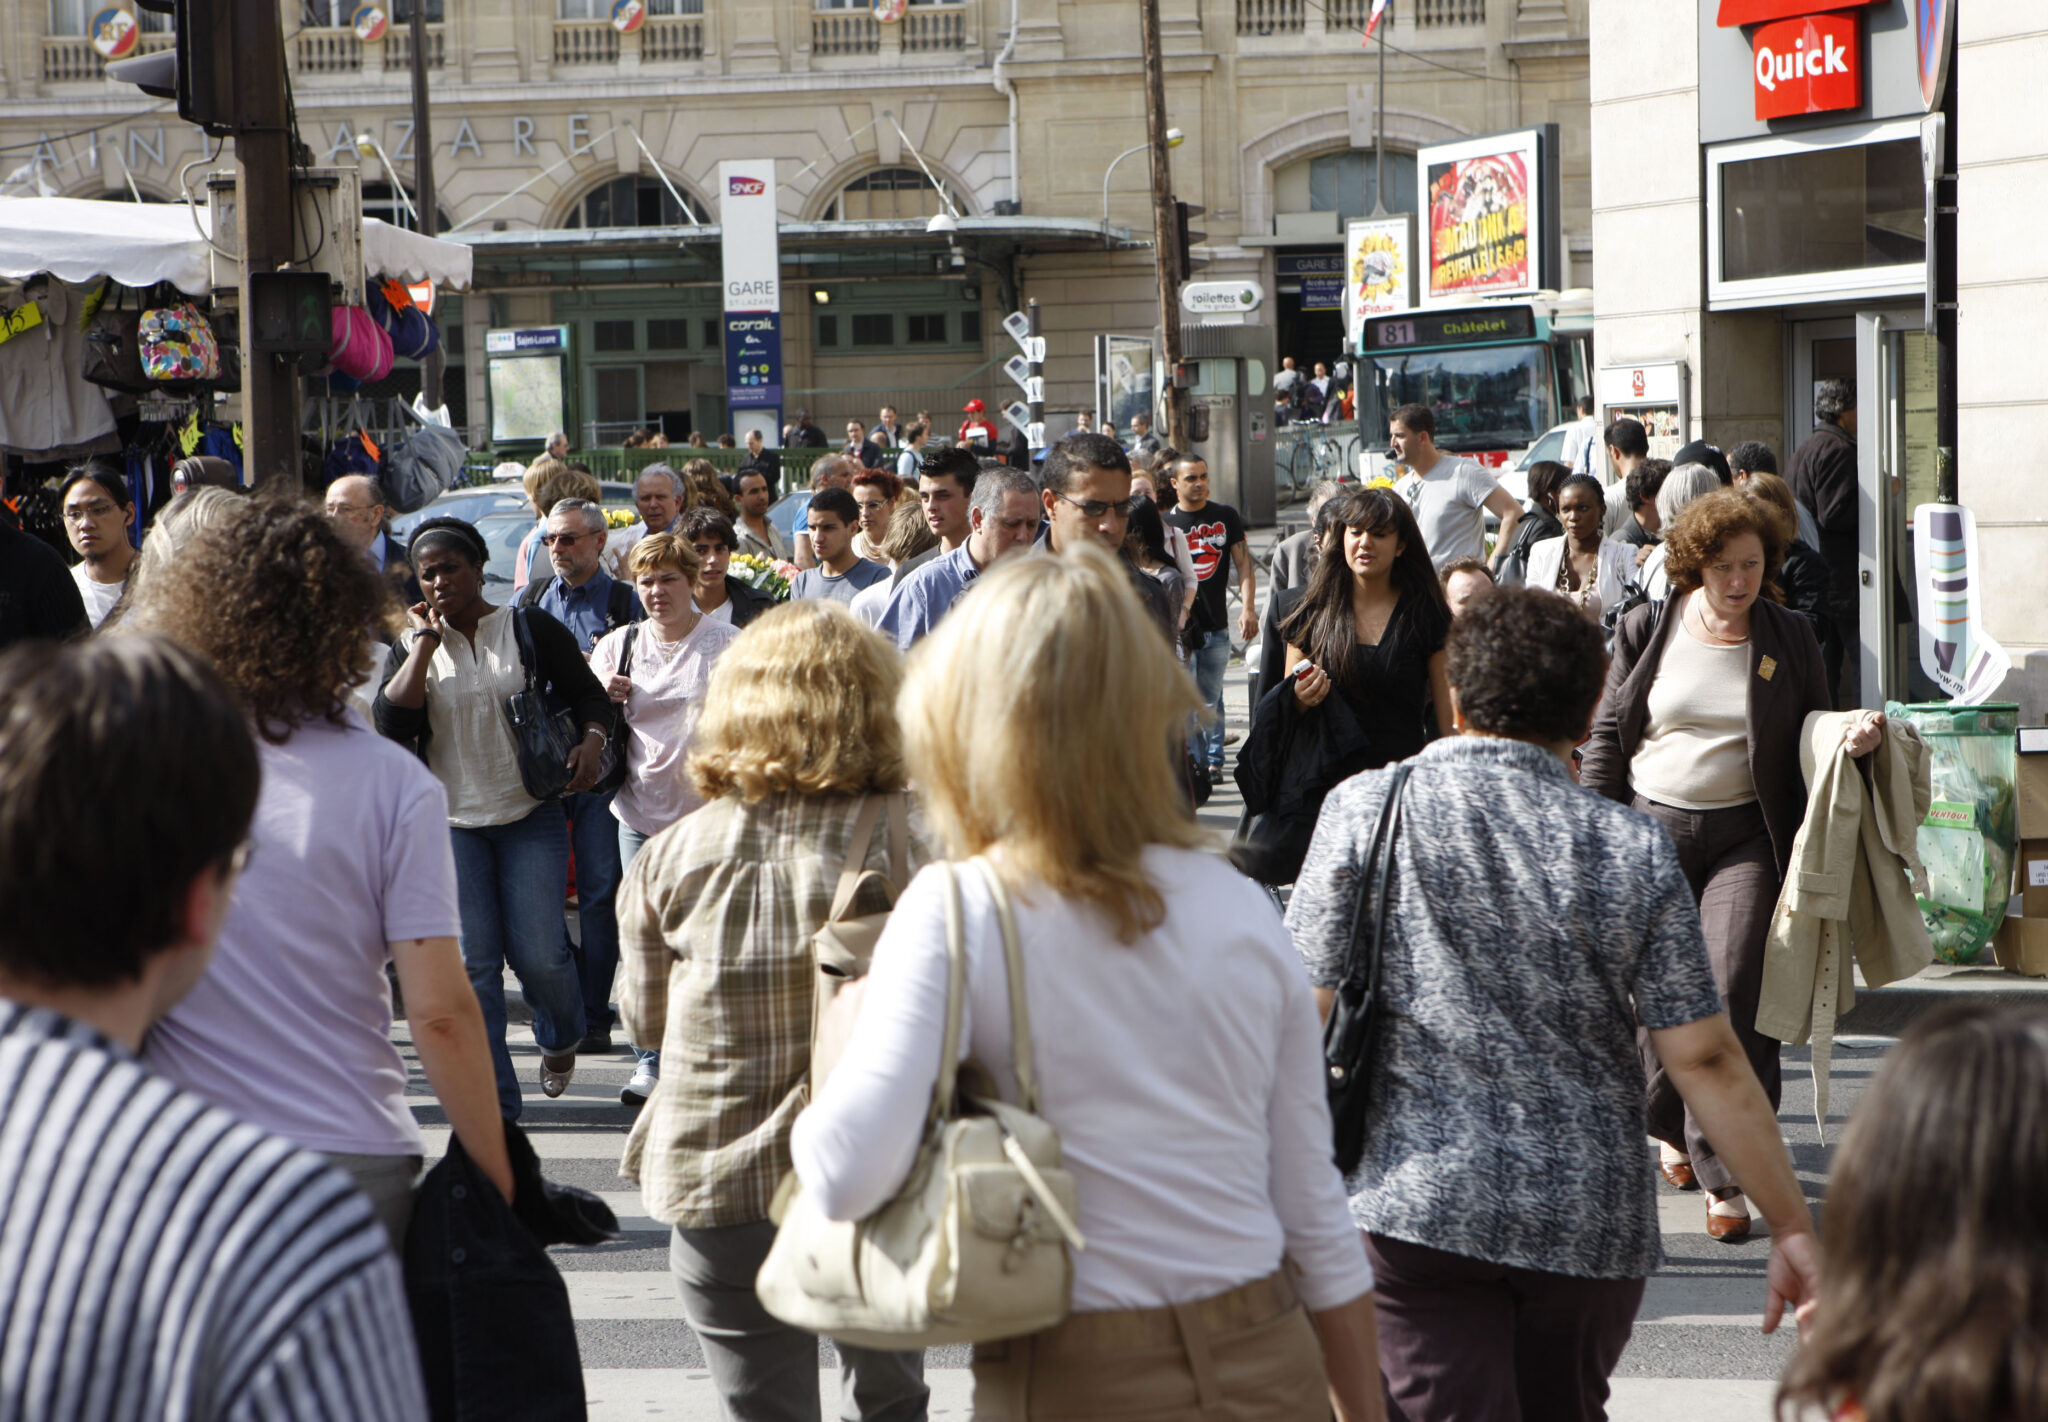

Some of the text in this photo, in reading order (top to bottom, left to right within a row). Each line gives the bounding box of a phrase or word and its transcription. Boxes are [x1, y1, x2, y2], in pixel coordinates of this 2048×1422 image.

[1755, 34, 1849, 92] Quick
[730, 182, 764, 195] SNCF
[728, 280, 775, 297] GARE
[729, 317, 776, 332] corail
[1385, 318, 1507, 344] 81 Châtelet
[516, 334, 557, 347] Saint-Lazare
[1930, 809, 1969, 821] VENTOUX
